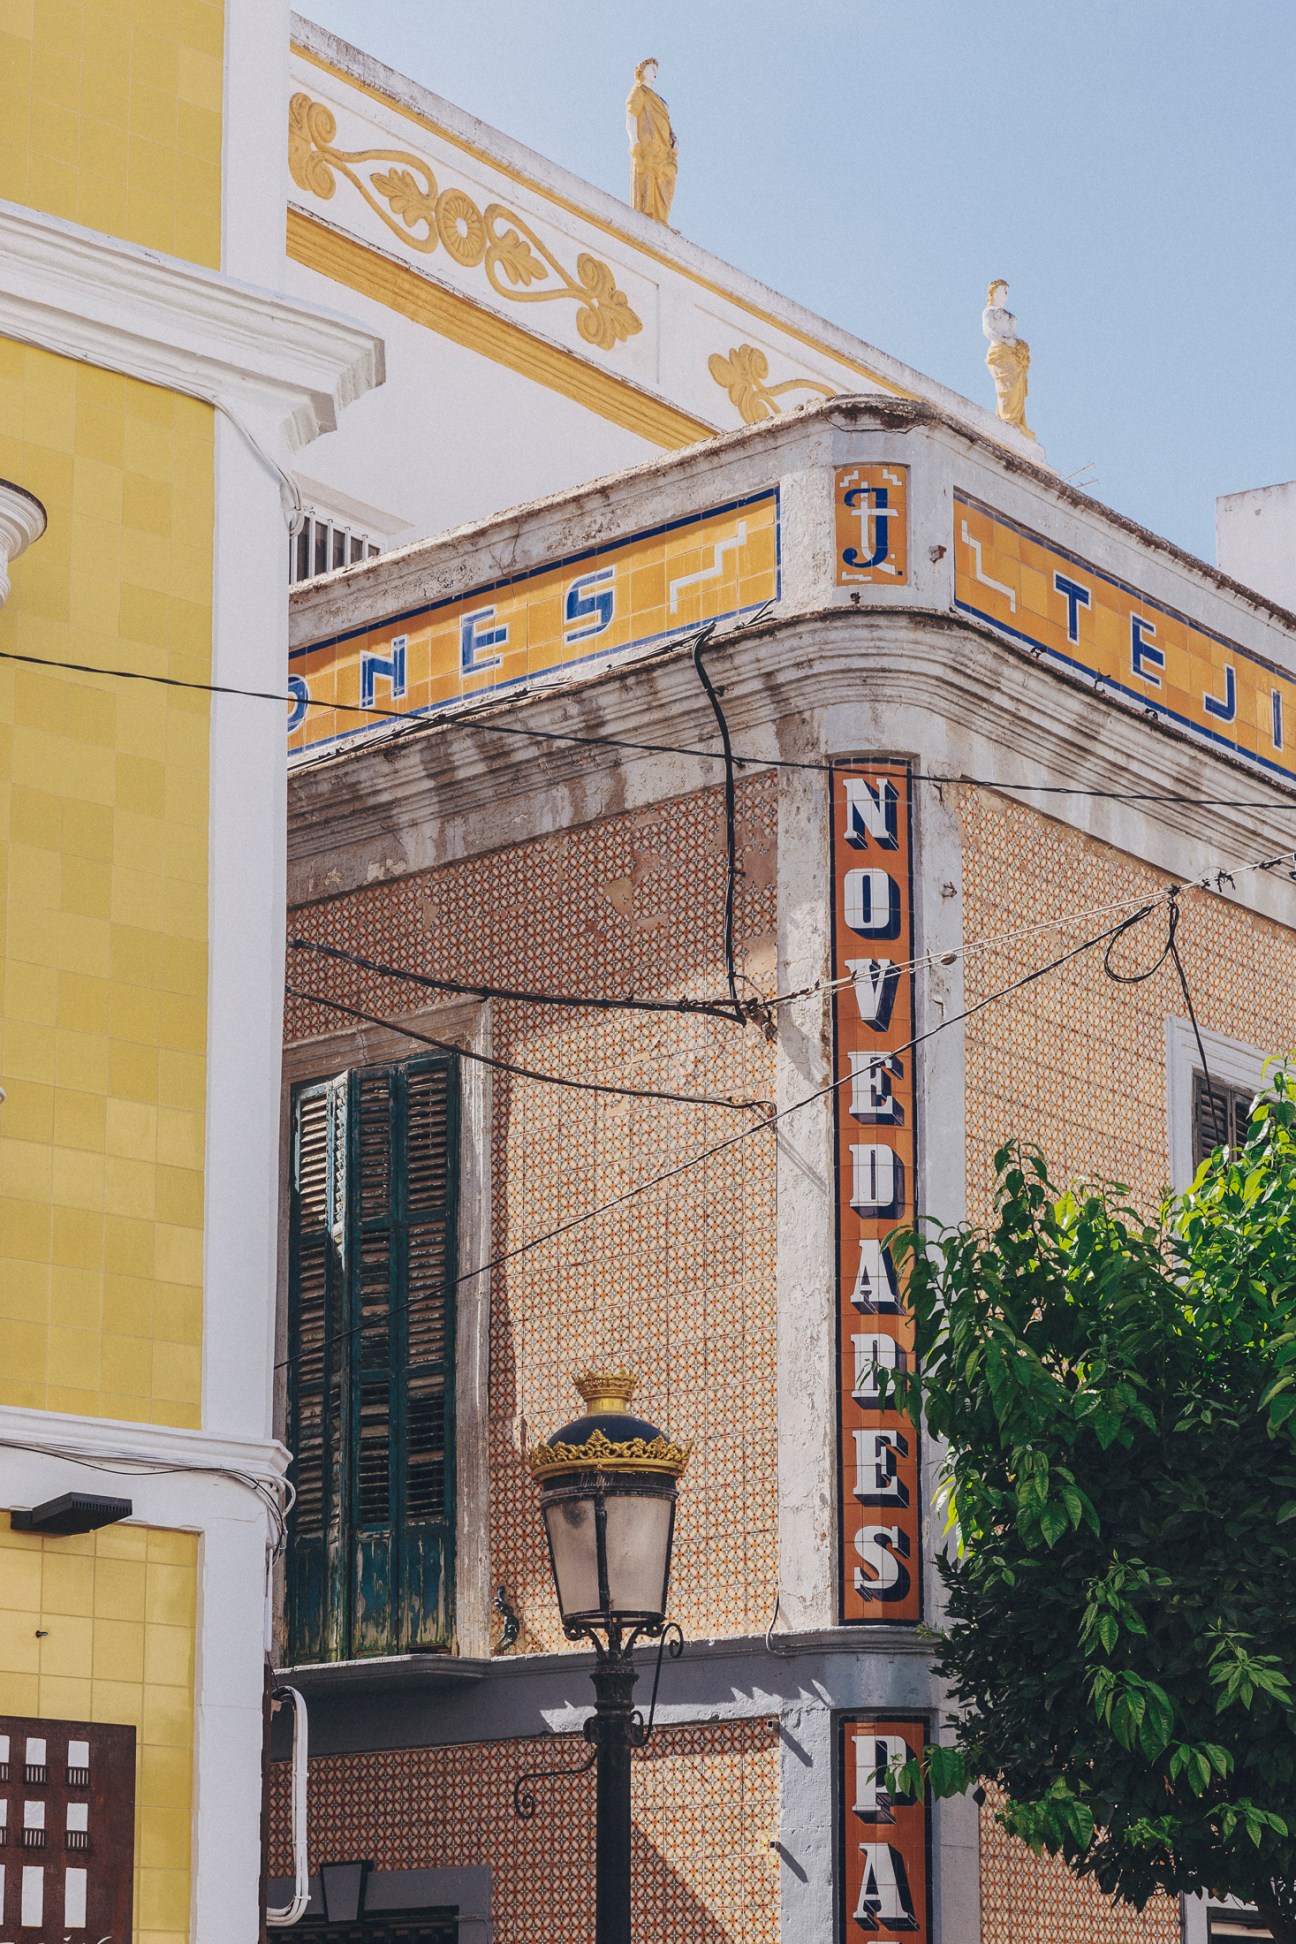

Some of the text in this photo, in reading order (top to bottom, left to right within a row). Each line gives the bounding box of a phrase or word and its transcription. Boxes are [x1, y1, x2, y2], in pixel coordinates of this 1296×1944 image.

[1053, 569, 1284, 752] TEJI
[842, 777, 910, 1602] NOVEDADES
[851, 1735, 920, 1944] PA
